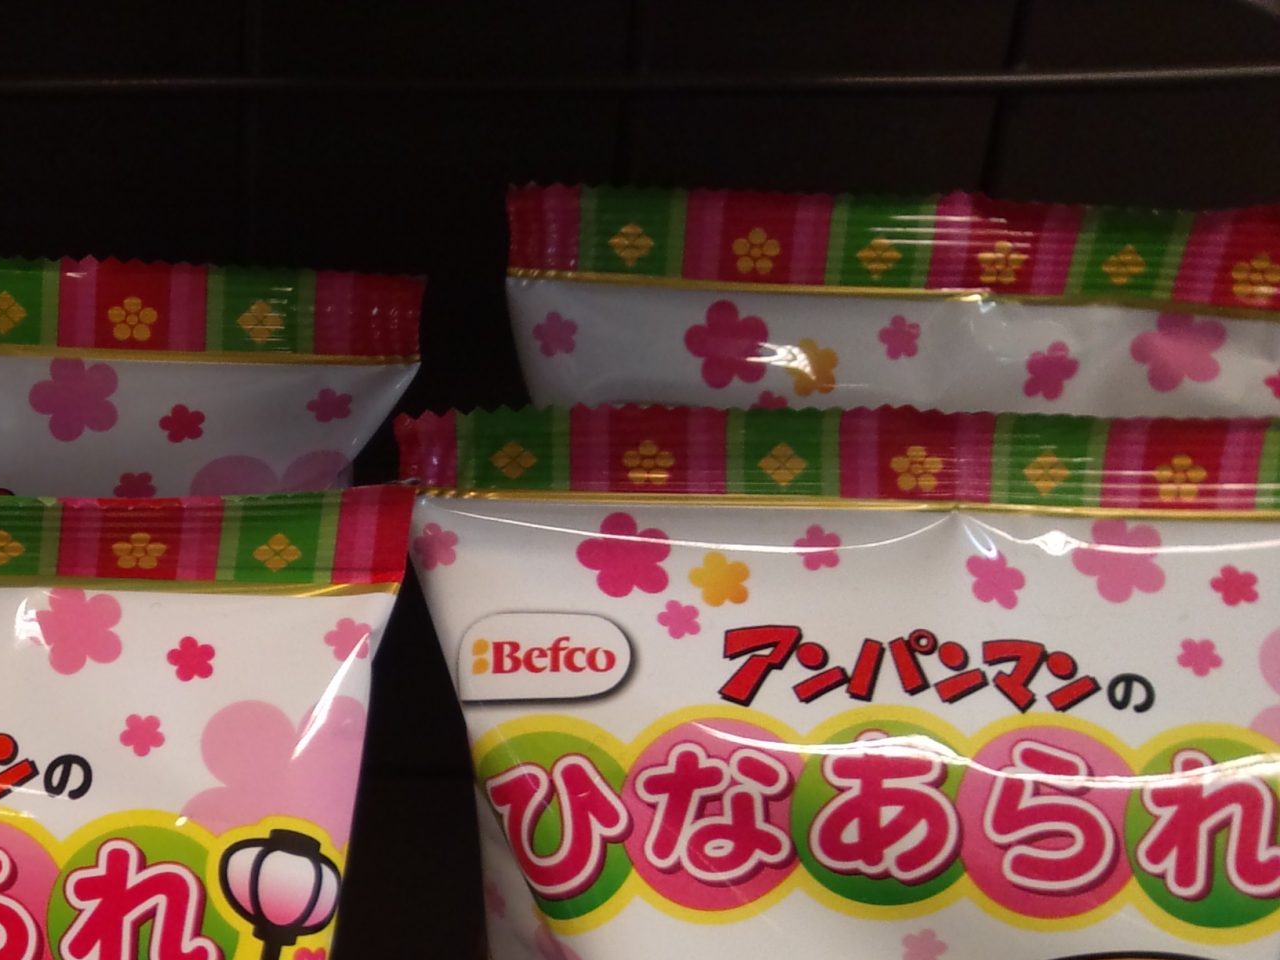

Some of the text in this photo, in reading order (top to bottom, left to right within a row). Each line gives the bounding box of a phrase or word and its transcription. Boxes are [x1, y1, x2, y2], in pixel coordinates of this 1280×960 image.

[491, 636, 616, 676] Befco
[719, 624, 1156, 712] アンパンマンの
[485, 730, 1280, 902] ひなあられ
